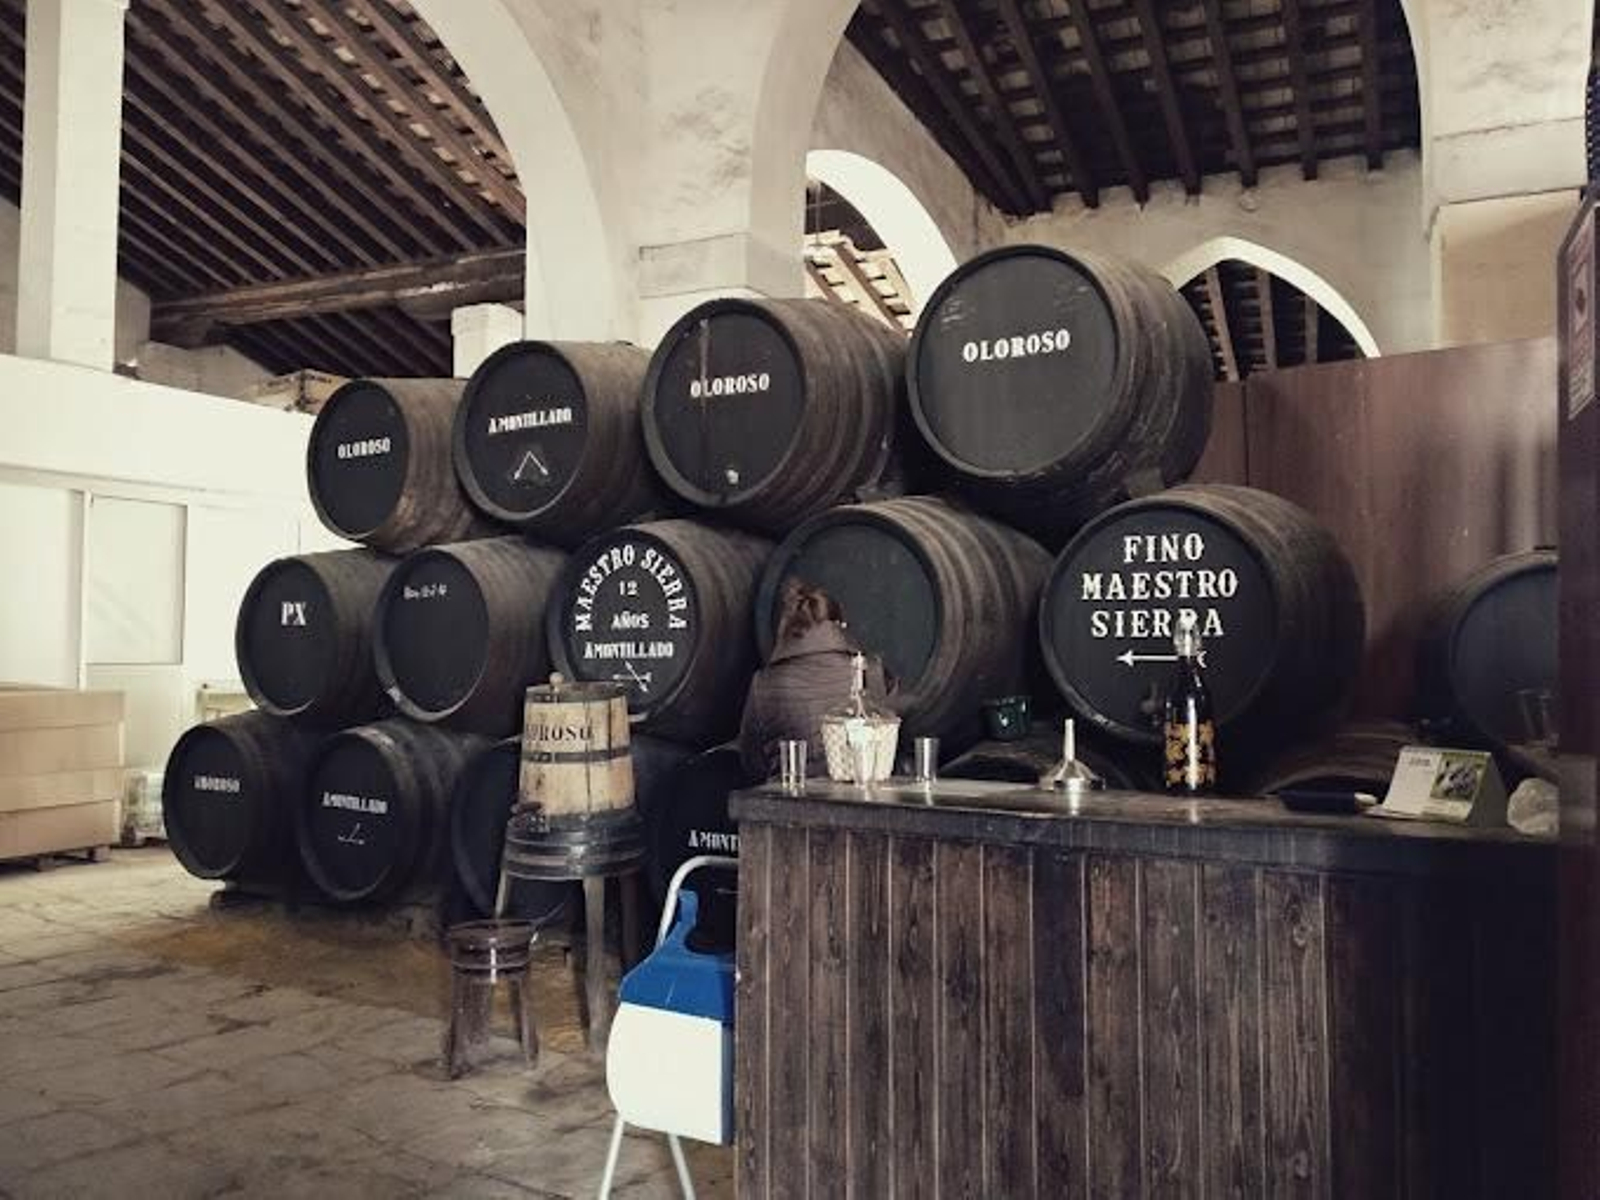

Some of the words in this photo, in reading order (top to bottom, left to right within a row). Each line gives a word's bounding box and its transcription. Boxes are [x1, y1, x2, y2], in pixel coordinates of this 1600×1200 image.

[962, 329, 1071, 362] OLOROSO
[690, 373, 770, 398] OLOROSO
[488, 407, 572, 434] AMONTILLADO
[337, 437, 391, 459] OLOROSO
[1123, 533, 1204, 563] FINO
[575, 545, 635, 631] MAESTRO
[640, 549, 687, 629] SIERRA
[619, 580, 640, 596] 12
[1082, 568, 1238, 600] MAESTRO
[281, 601, 306, 626] PX
[611, 611, 650, 629] AÑOS
[584, 641, 674, 659] AMONTILLADO
